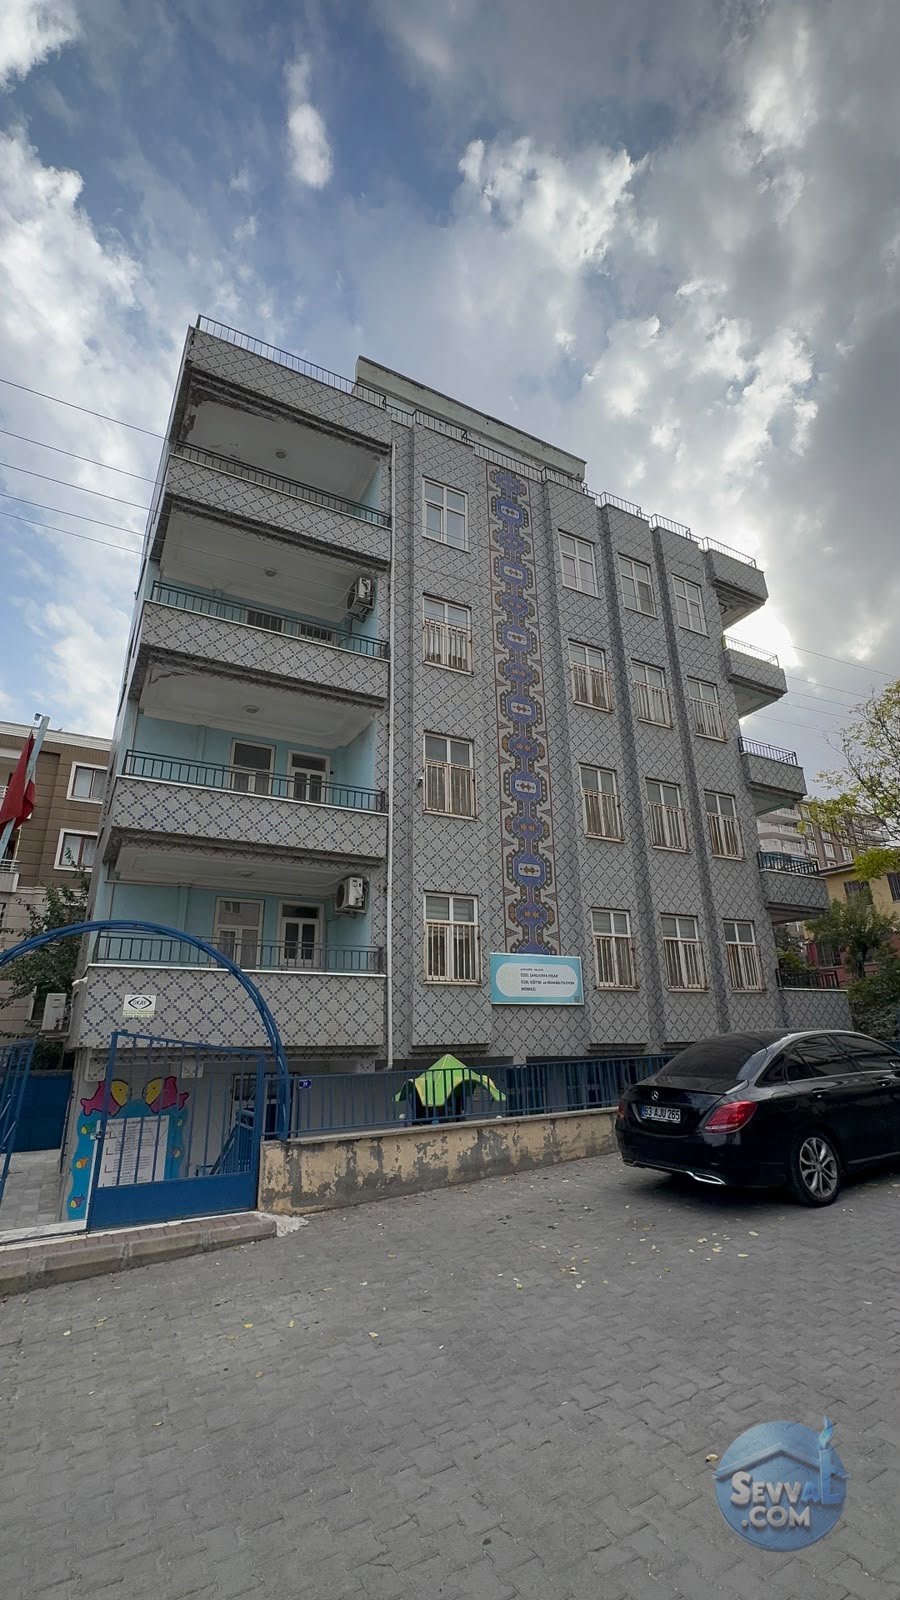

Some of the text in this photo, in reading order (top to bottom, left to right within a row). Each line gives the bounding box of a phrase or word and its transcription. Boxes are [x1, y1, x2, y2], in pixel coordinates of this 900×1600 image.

[644, 1106, 680, 1120] 63 AJU 265
